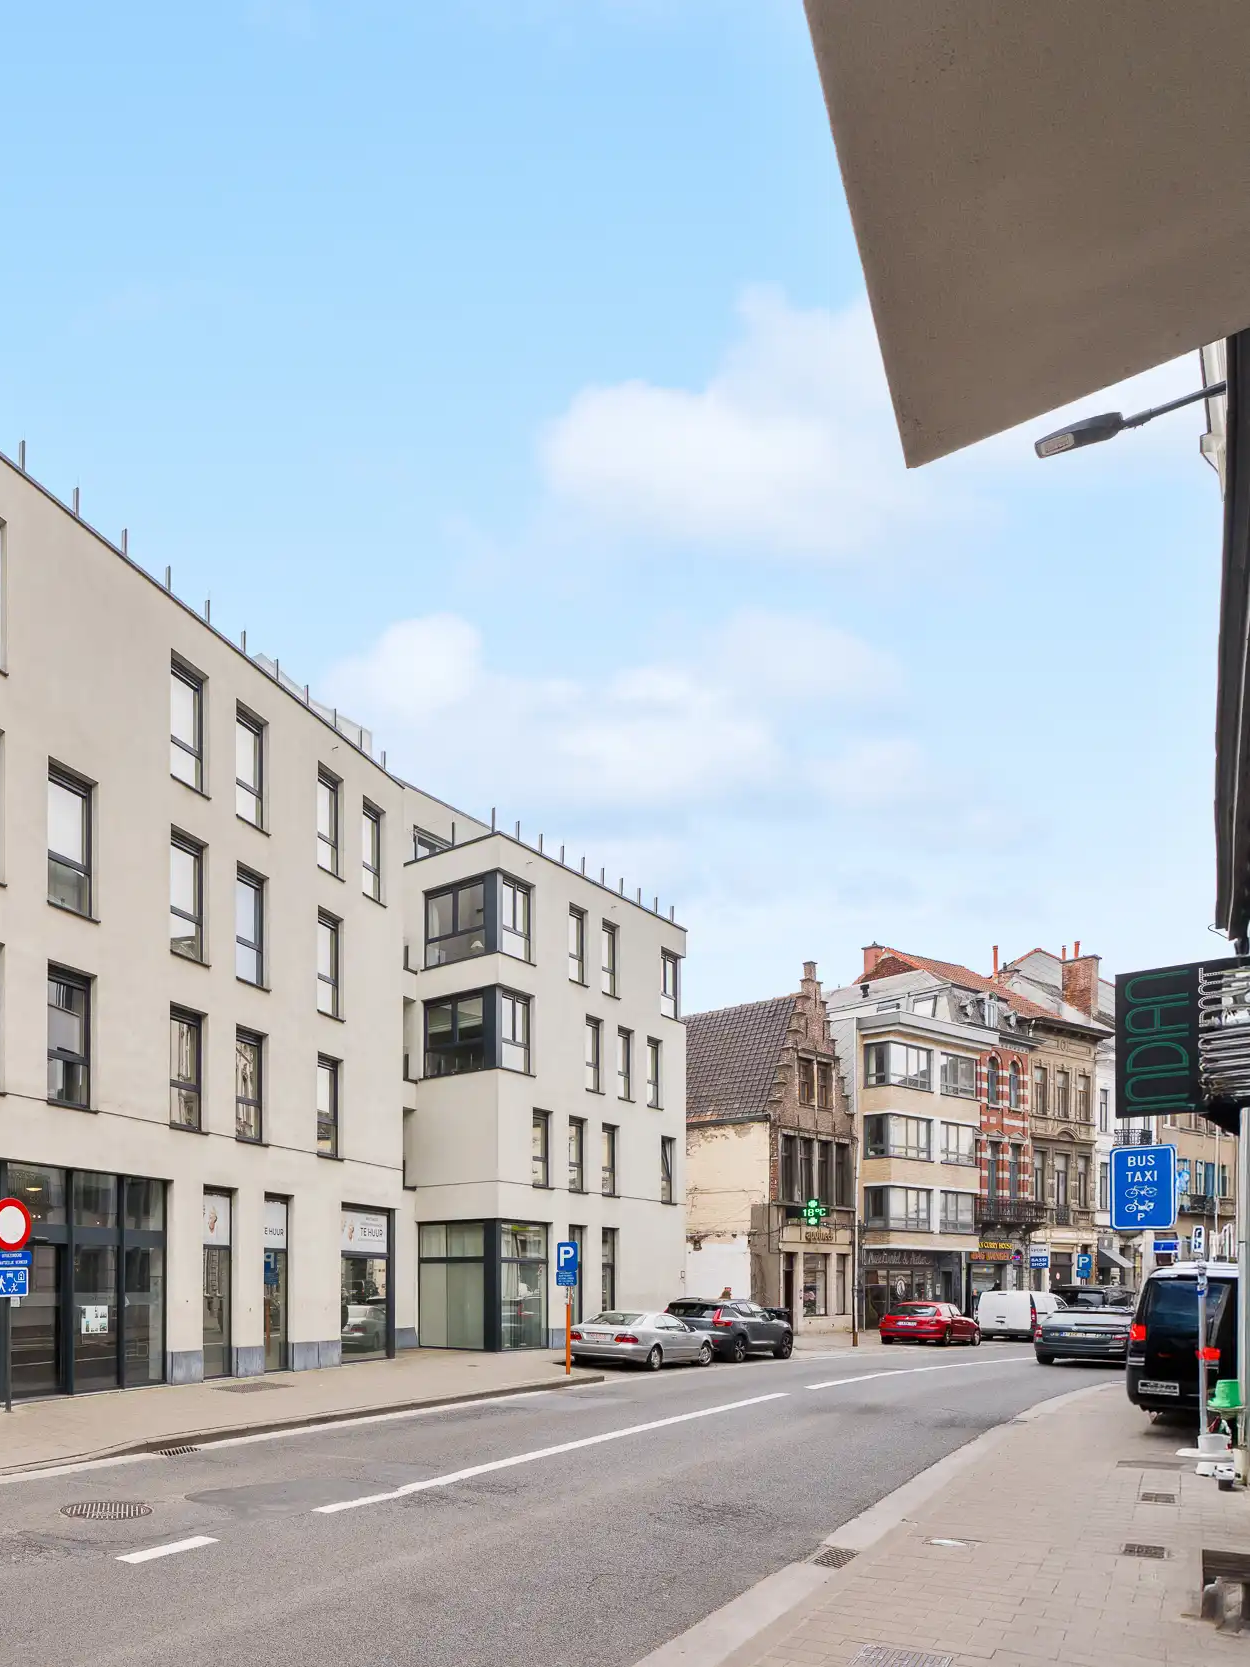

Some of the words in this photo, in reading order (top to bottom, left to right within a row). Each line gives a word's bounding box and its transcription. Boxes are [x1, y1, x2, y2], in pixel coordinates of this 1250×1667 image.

[1125, 969, 1190, 1112] INDIAN
[1127, 1154, 1155, 1167] BUS
[1125, 1170, 1158, 1182] TAXI
[802, 1208, 826, 1217] 18°C
[1137, 1213, 1146, 1221] P
[268, 1228, 284, 1236] HUUR
[360, 1227, 367, 1237] TE
[367, 1228, 383, 1238] HUUR
[560, 1246, 574, 1266] P
[1079, 1256, 1089, 1268] P
